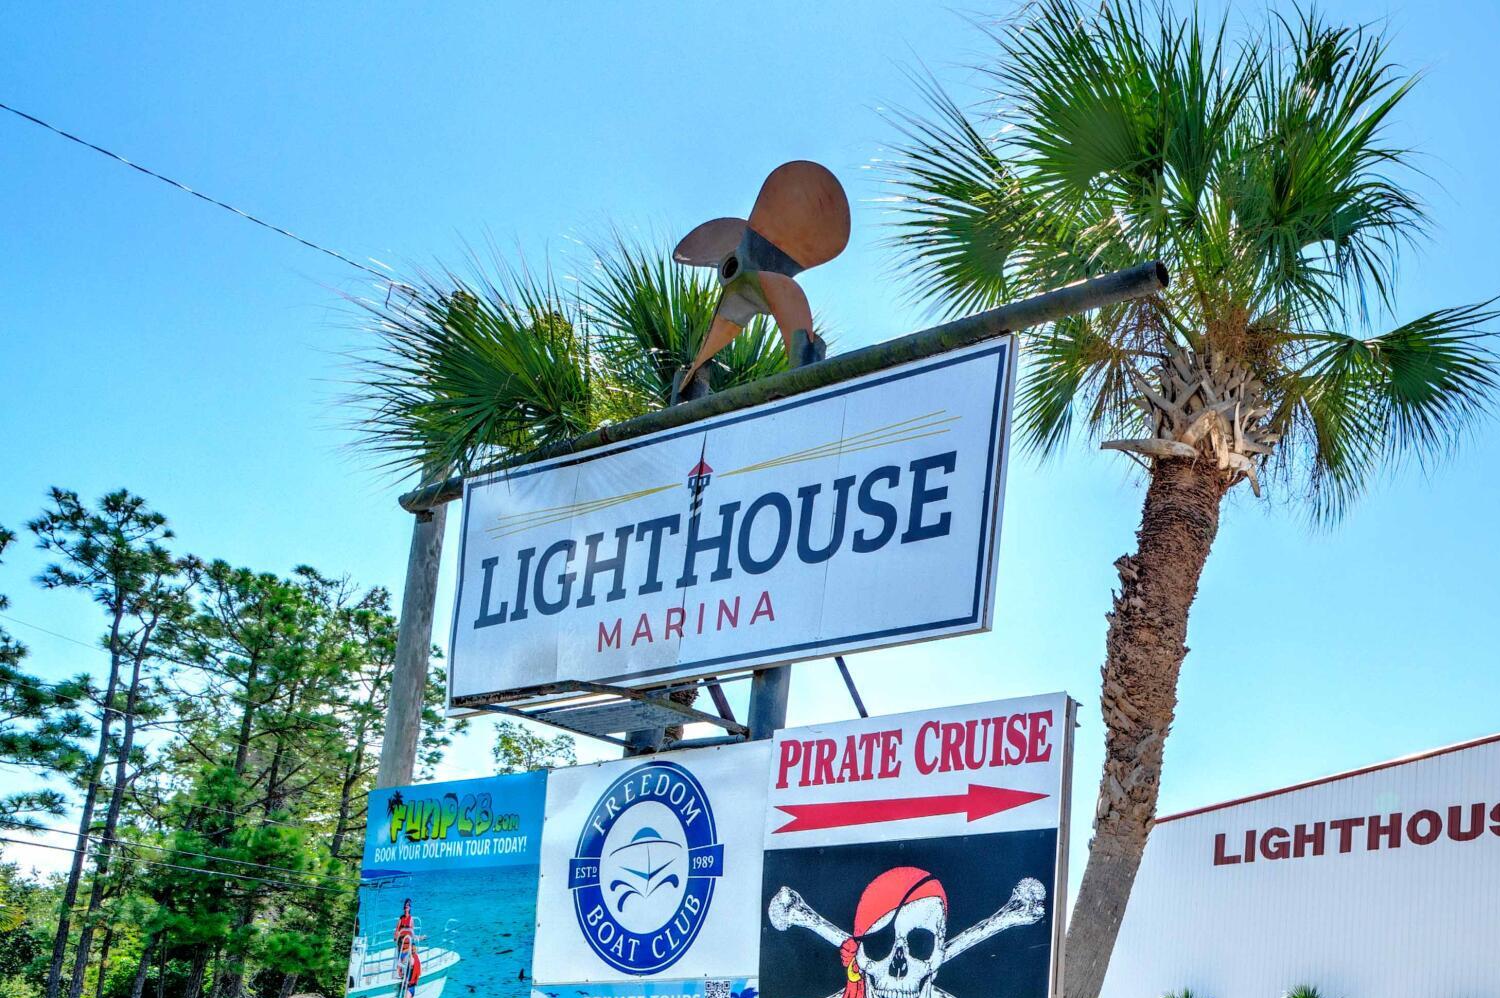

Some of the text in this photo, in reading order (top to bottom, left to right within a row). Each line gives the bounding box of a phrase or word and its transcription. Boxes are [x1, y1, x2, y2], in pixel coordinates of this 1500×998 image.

[474, 450, 957, 629] LIGHTHOUSE
[597, 590, 775, 652] MARINA
[775, 709, 1053, 789] PIRATE CRUISE
[593, 774, 702, 836] FREEDOM
[374, 835, 528, 863] BOOK YOUR DOLPHIN TOUR TODAY!
[692, 855, 715, 869] 1989
[586, 894, 701, 961] BOAT CLUB
